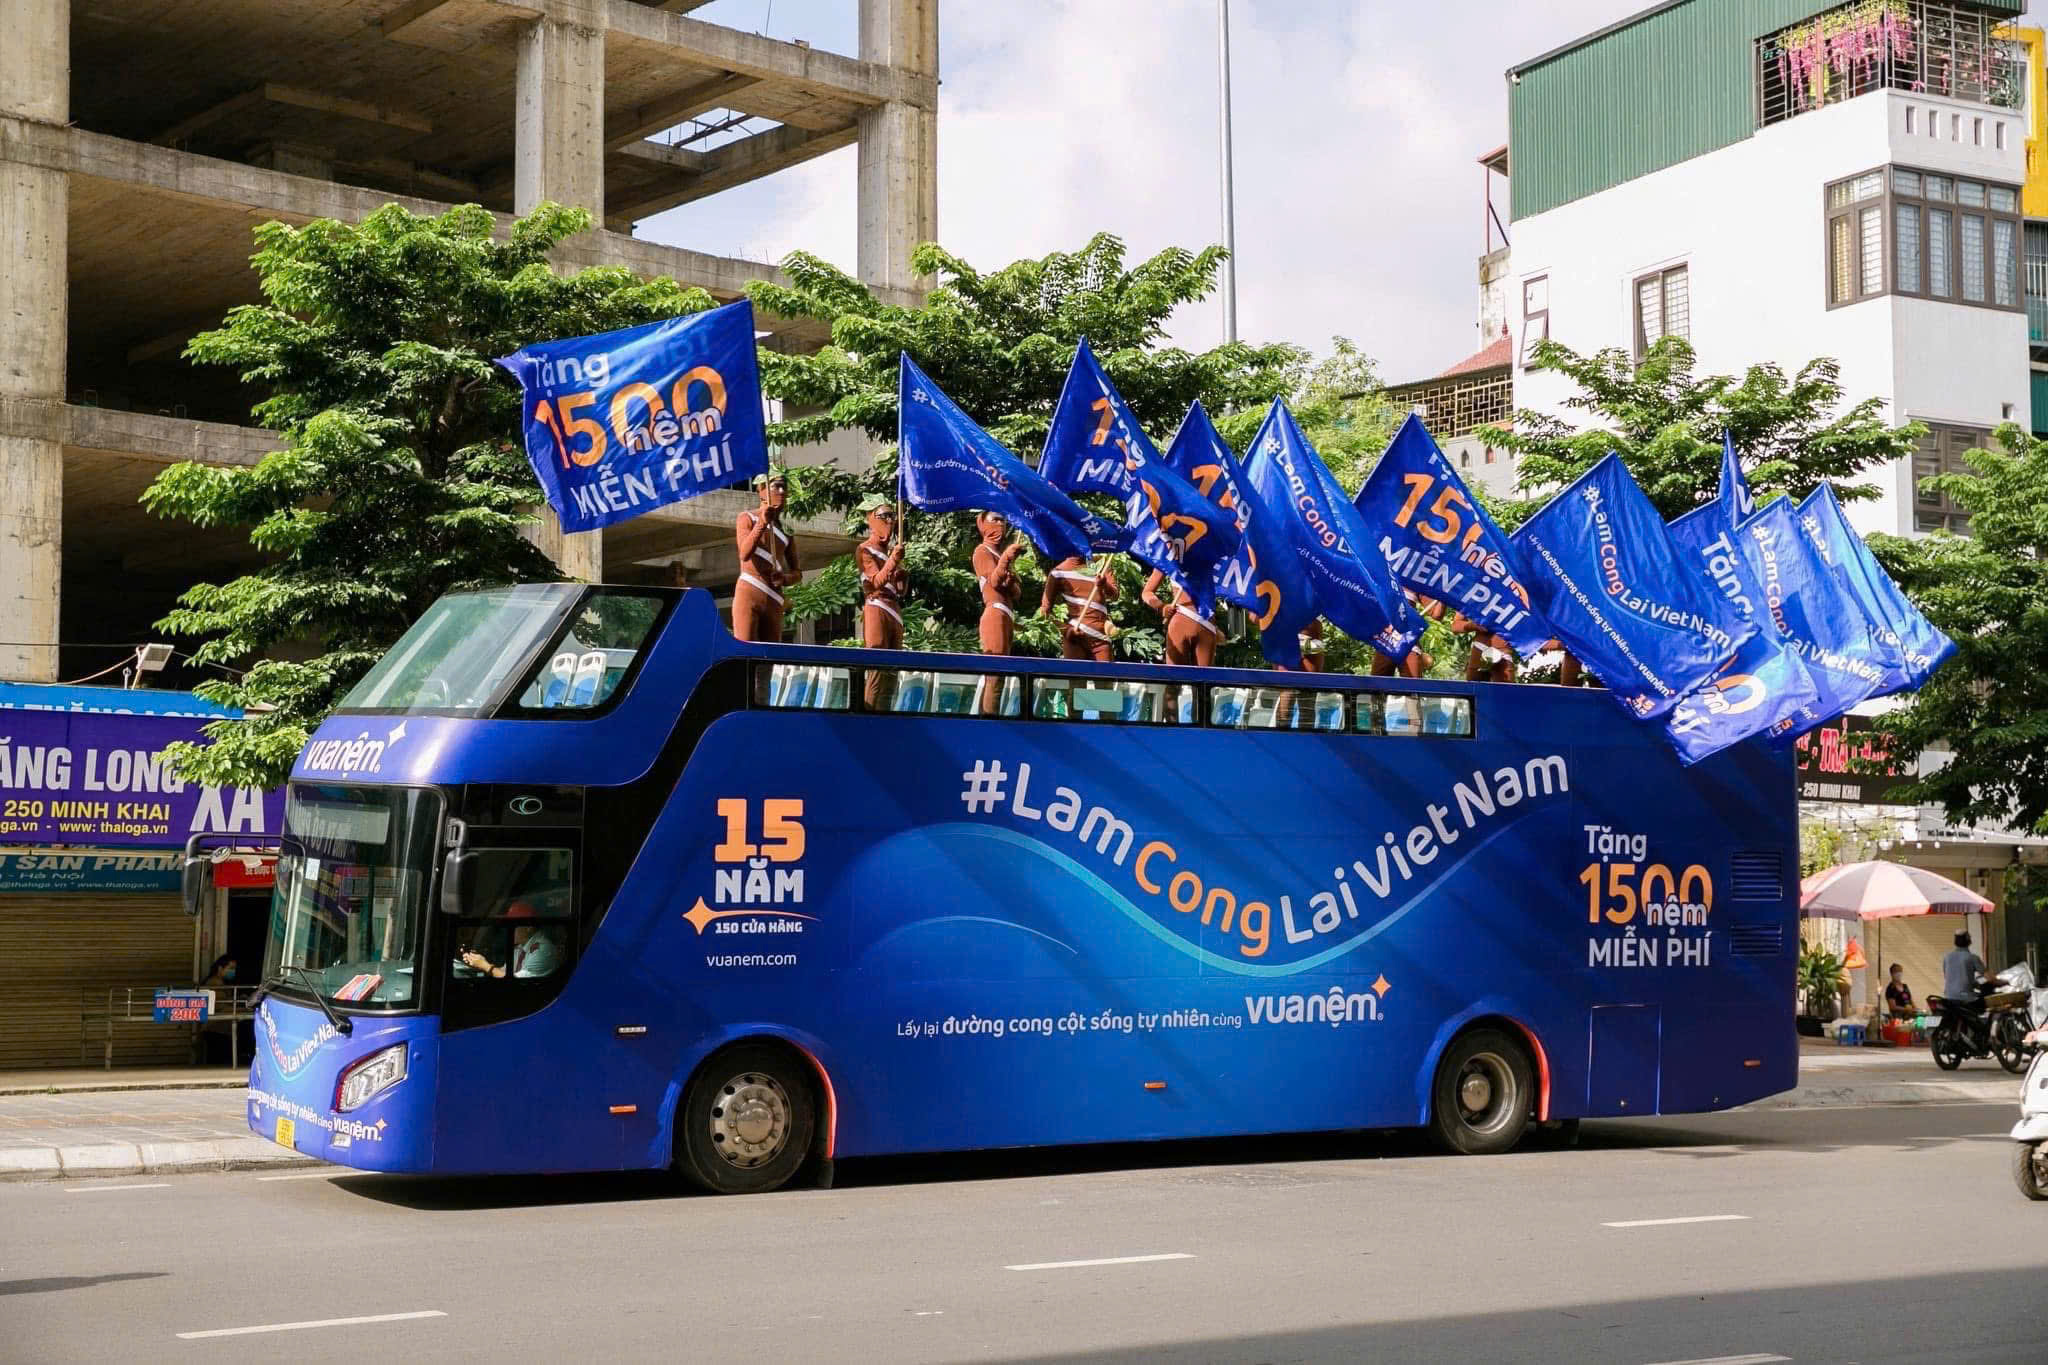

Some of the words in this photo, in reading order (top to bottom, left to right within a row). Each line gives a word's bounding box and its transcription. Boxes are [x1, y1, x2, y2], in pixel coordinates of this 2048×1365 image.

[535, 365, 727, 469] 1500
[624, 407, 722, 457] nệm
[664, 433, 734, 492] PHÍ
[1378, 535, 1462, 593] MIỄN
[1462, 575, 1530, 631] PHÍ
[1561, 574, 1577, 594] cong
[4, 800, 44, 817] 250
[51, 802, 108, 819] MINH
[117, 803, 170, 821] KHAI
[101, 822, 168, 836] thaloga.vn
[715, 799, 806, 862] 15
[1584, 825, 1647, 863] Tặng
[715, 858, 804, 903] NĂM
[1579, 863, 1713, 924] 1500
[715, 922, 738, 934] 150
[1647, 894, 1707, 935] nệm
[707, 954, 797, 967] vuanem.com
[1589, 925, 1658, 967] MIỄN
[1667, 931, 1712, 966] PHÍ
[898, 1018, 920, 1038] Lấy
[924, 1021, 939, 1037] lại
[942, 1014, 1004, 1037] đường
[1009, 1018, 1053, 1035] cong
[1058, 1010, 1086, 1035] cột
[1090, 1009, 1133, 1034] sống
[1138, 1012, 1158, 1032] tự
[1162, 1008, 1209, 1028] nhiên
[1213, 1012, 1242, 1029] cùng
